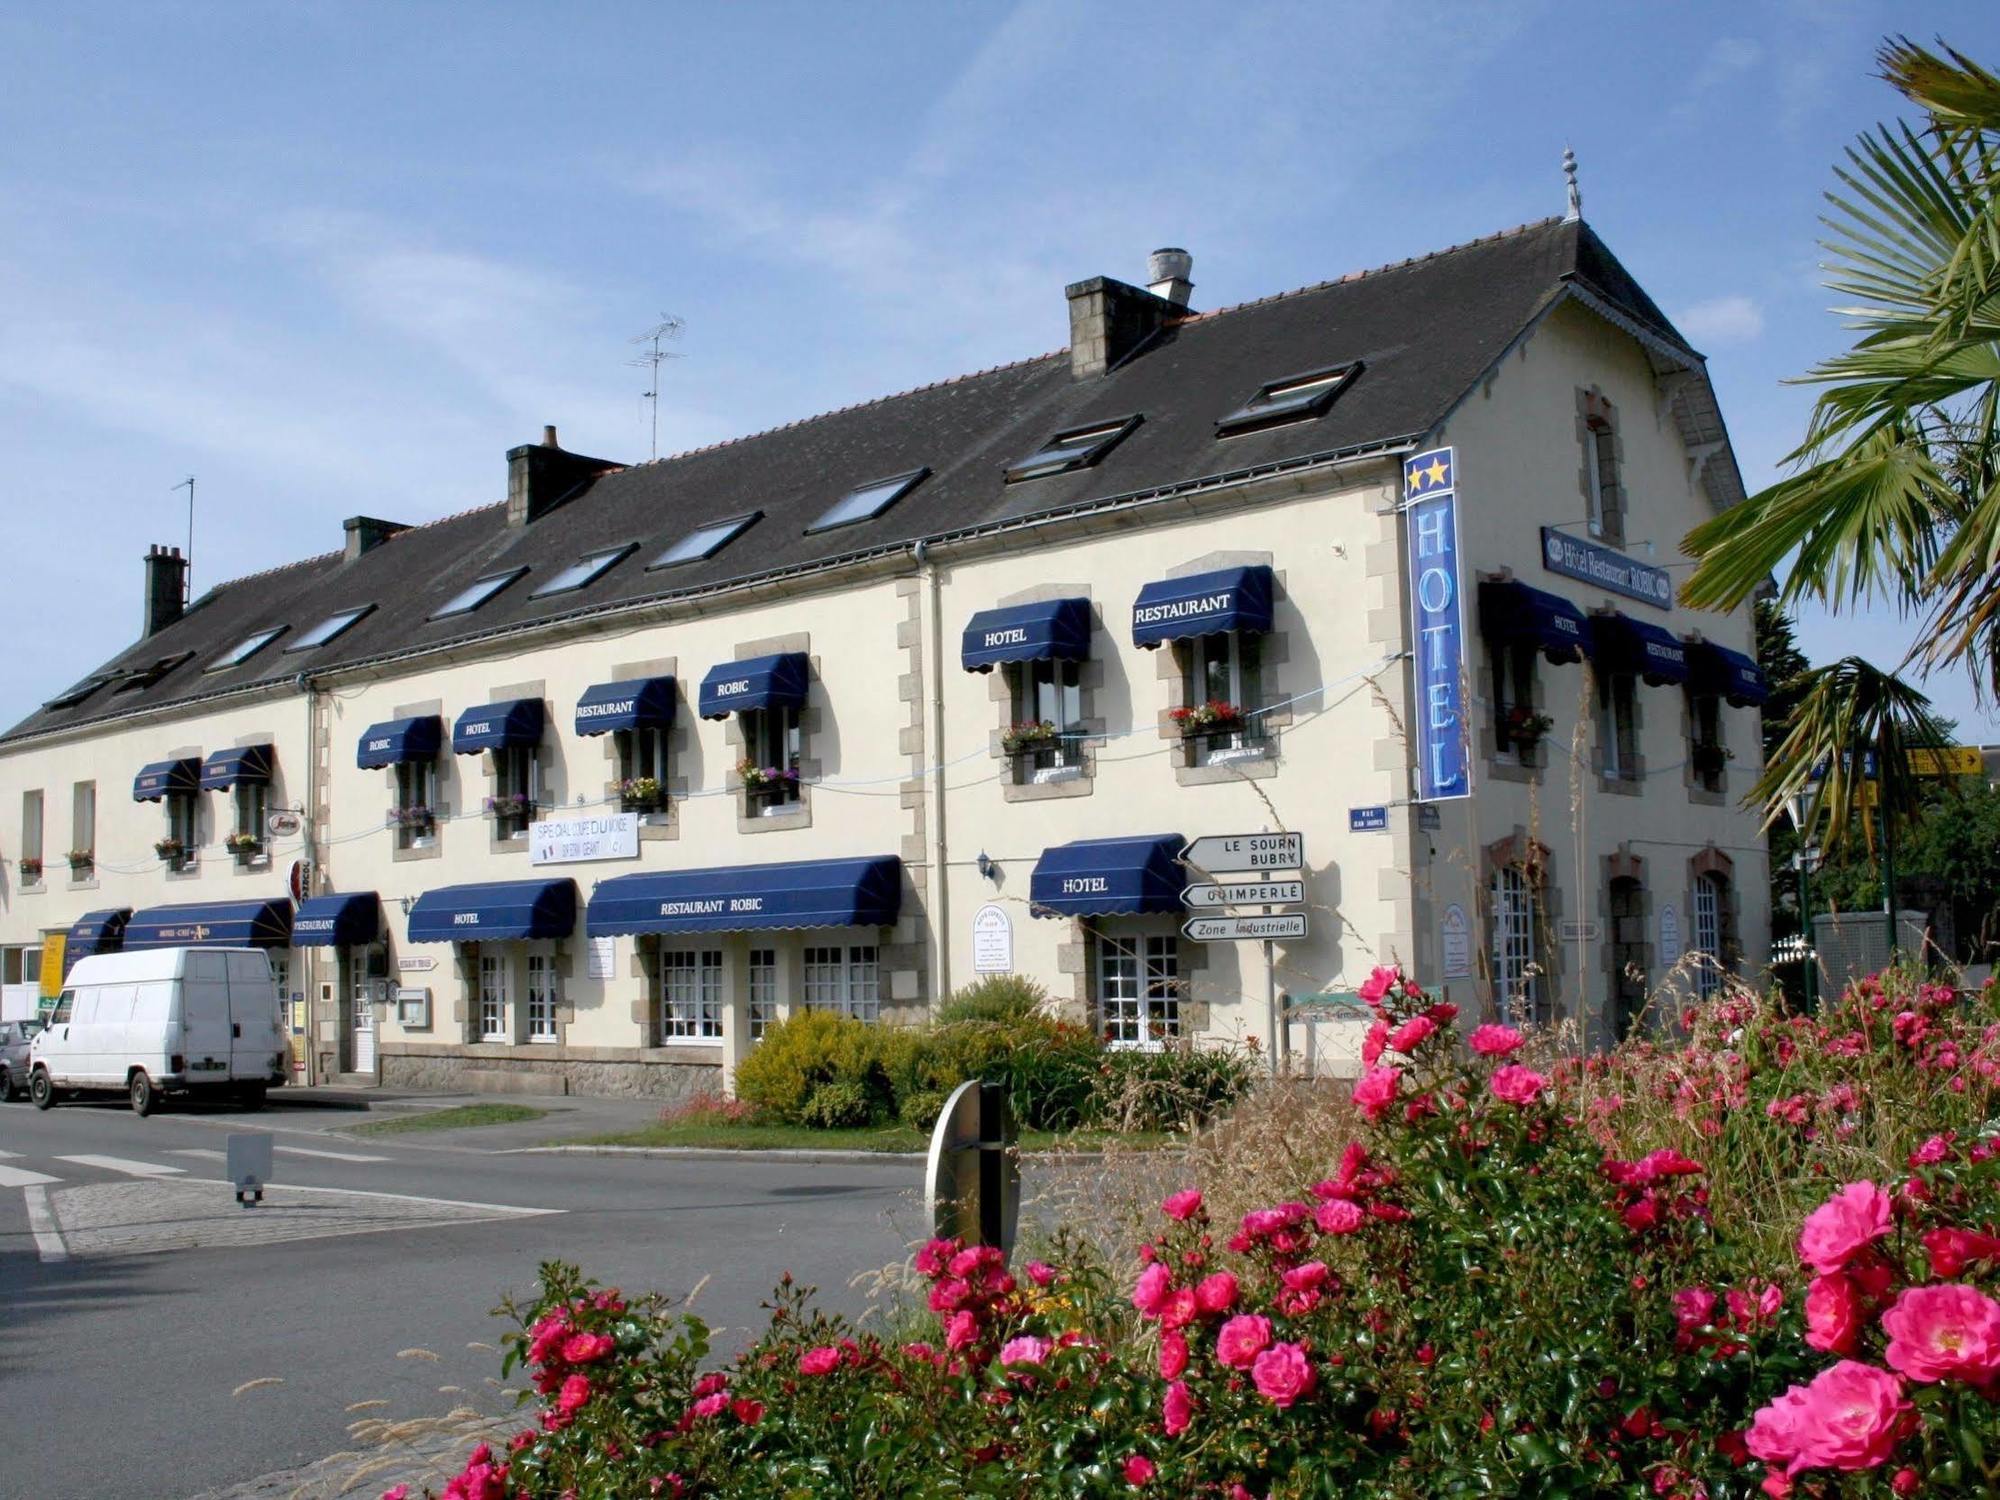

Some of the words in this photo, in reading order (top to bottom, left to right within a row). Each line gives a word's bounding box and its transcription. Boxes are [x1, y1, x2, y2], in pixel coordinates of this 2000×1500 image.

[1563, 542, 1587, 574] Hôtel
[1587, 551, 1631, 587] Restaurant
[1630, 567, 1657, 597] ROBIC
[1135, 594, 1231, 624] RESTAURANT
[1554, 614, 1579, 635] HOTEL
[985, 628, 1027, 647] HOTEL
[1416, 507, 1457, 787] HOTEL
[717, 679, 749, 696] ROBIC
[576, 701, 634, 718] RESTAURANT
[466, 722, 491, 735] HOTEL
[370, 738, 391, 750] ROBIC
[591, 820, 608, 834] DU
[1225, 841, 1240, 852] LE
[1251, 838, 1296, 851] SOURN
[1251, 853, 1296, 865] BUBRY
[1062, 878, 1108, 893] HOTEL
[661, 900, 725, 915] RESTAURANT
[730, 898, 763, 911] ROBIC
[454, 913, 479, 924] HOTEL
[1198, 924, 1226, 935] Zone
[1235, 921, 1300, 934] Industrielle
